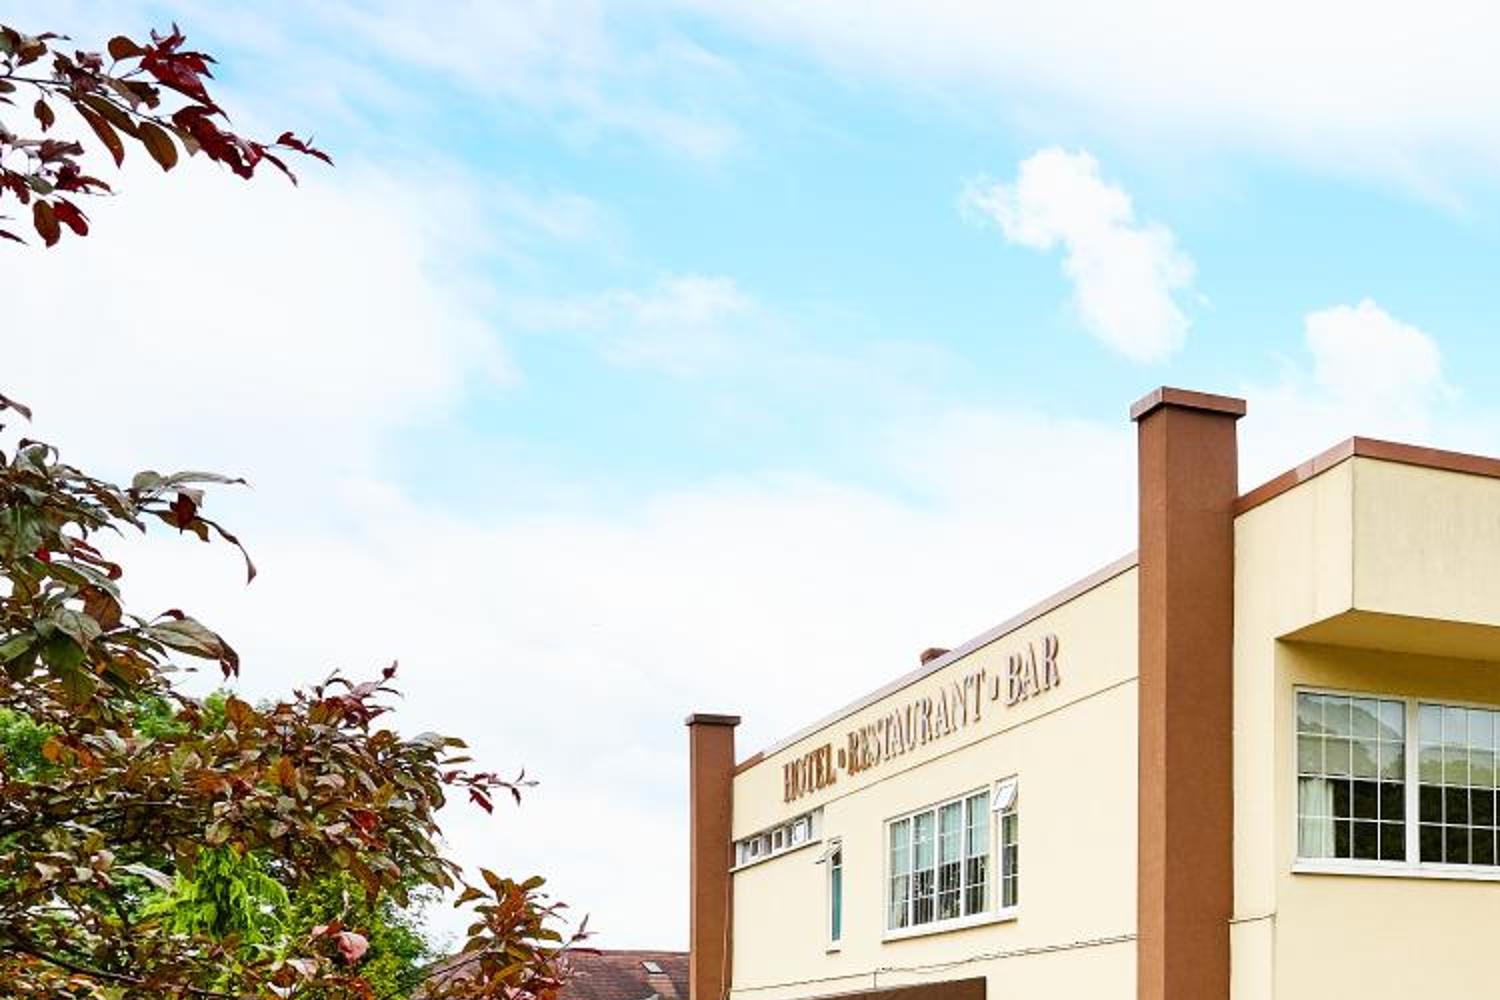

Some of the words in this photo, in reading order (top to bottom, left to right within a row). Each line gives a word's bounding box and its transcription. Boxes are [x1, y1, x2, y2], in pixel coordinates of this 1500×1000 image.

[783, 742, 836, 803] HOTEL
[845, 667, 986, 776] RESTAURANT
[1006, 633, 1061, 707] BAR
